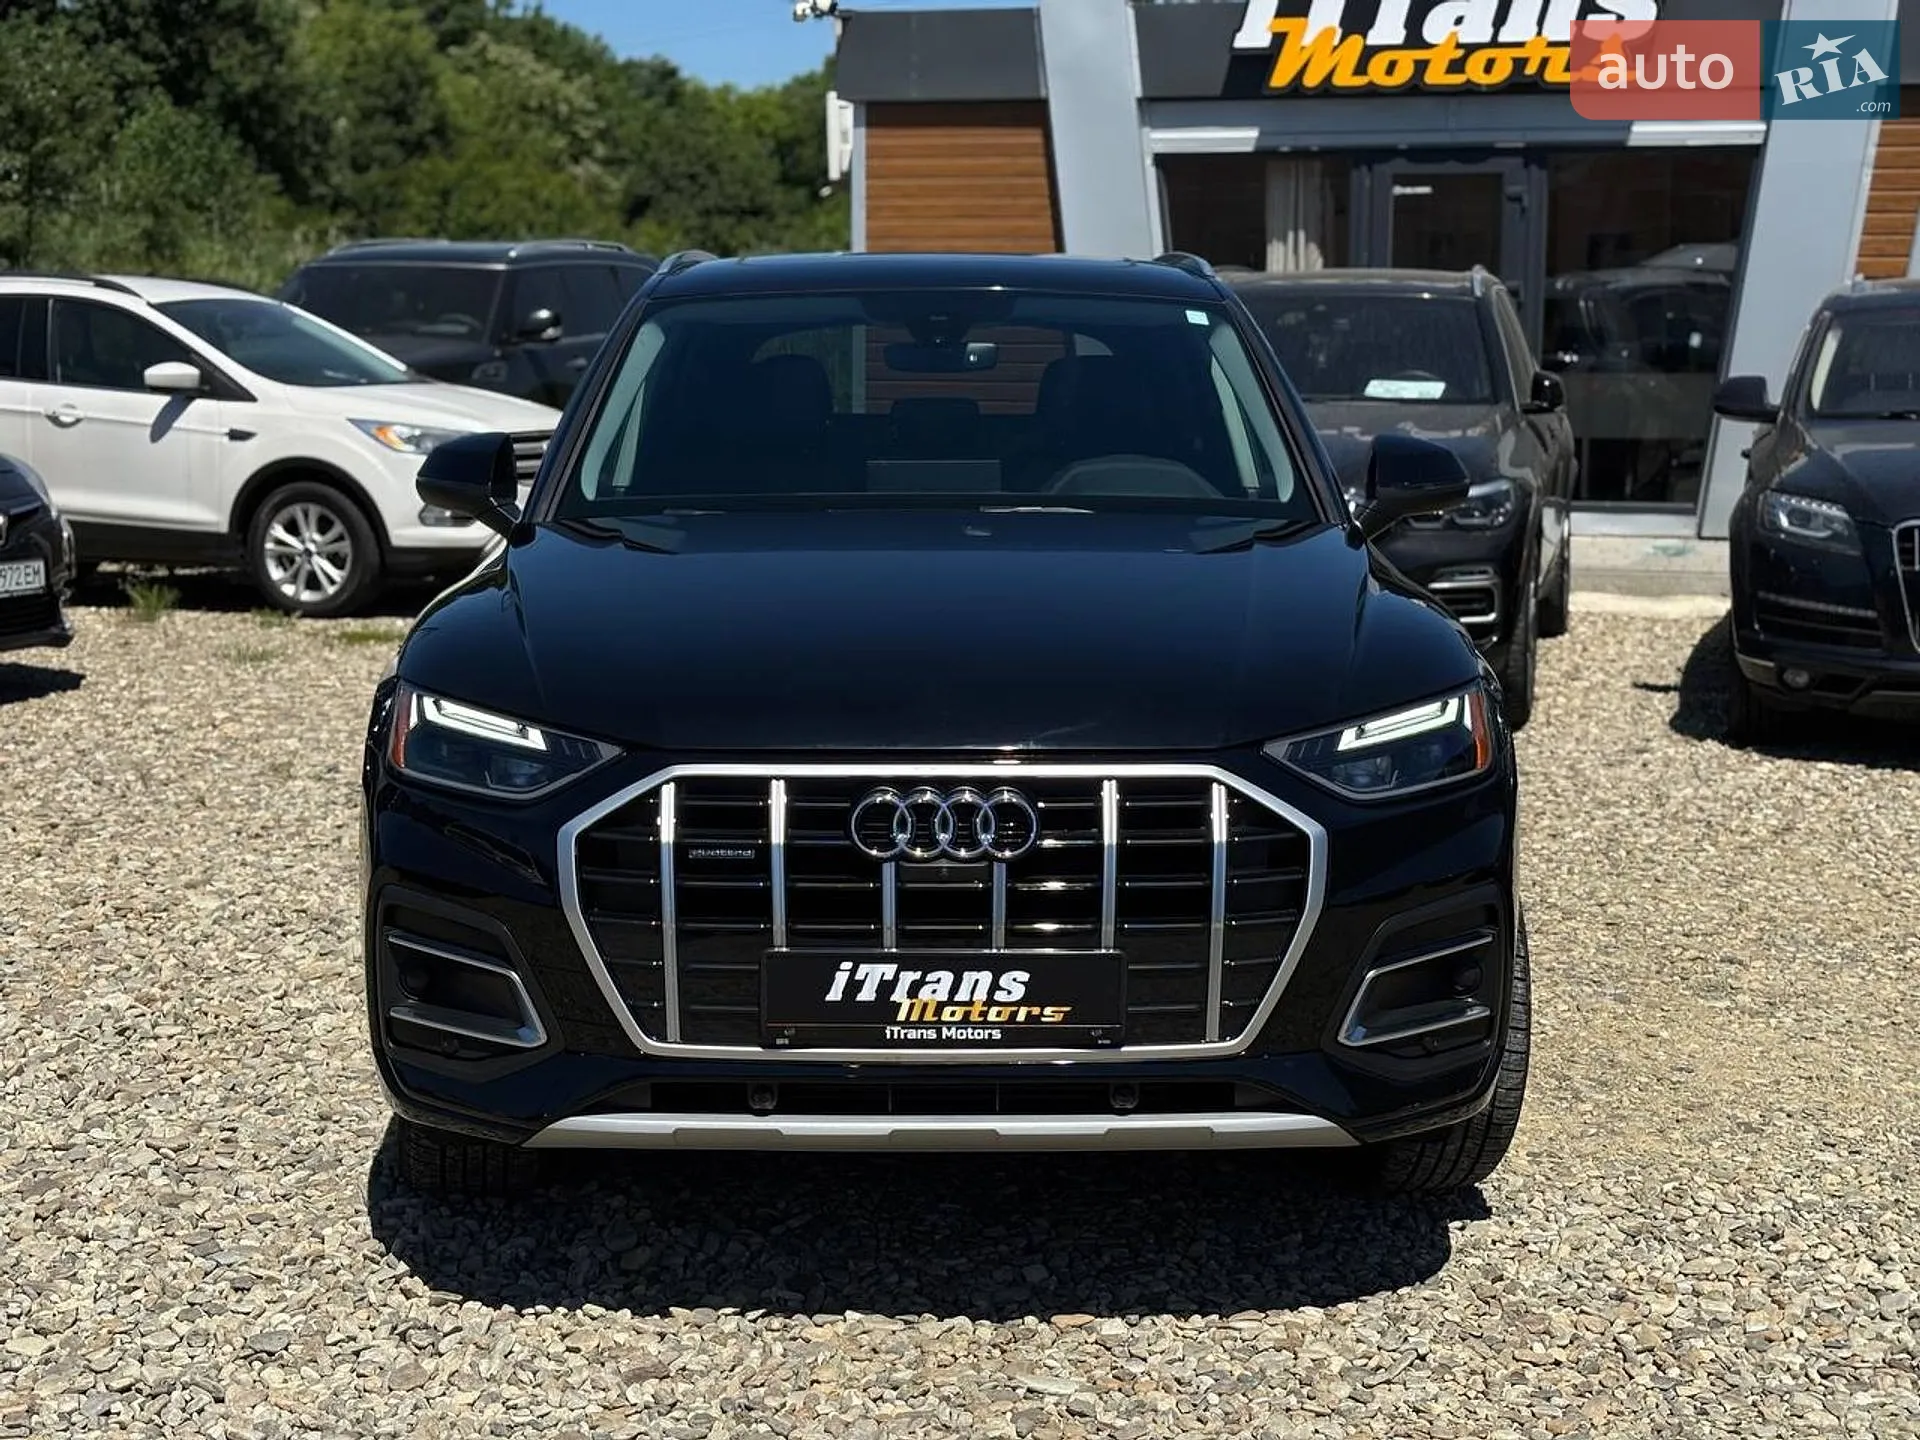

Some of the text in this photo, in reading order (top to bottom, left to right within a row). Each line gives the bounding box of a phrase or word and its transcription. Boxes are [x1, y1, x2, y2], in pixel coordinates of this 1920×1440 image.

[825, 961, 1031, 1002] iTrans
[896, 998, 1072, 1022] Motors
[886, 1026, 1001, 1039] iTrans Motors
